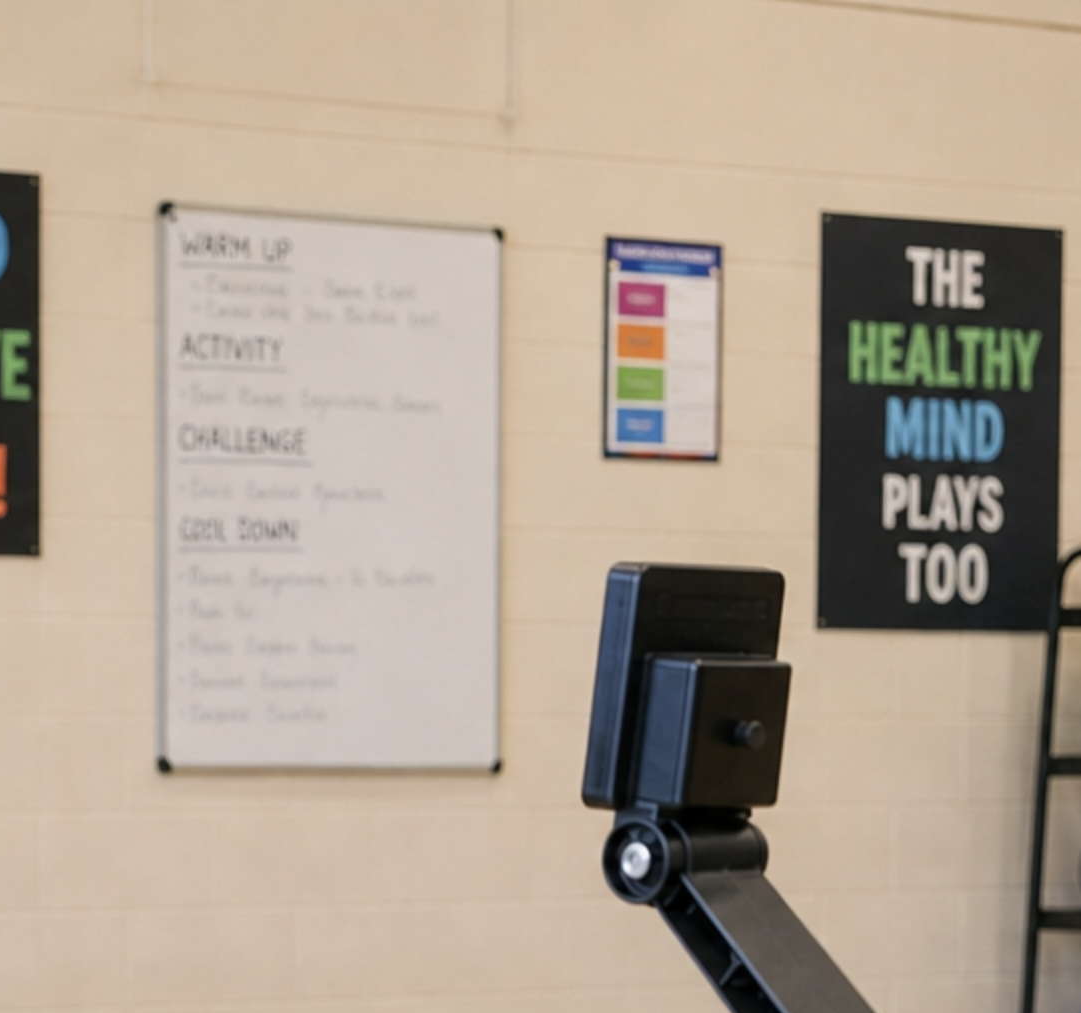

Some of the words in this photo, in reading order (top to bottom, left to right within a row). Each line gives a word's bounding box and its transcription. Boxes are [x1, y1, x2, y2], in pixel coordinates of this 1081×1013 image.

[179, 231, 252, 260] WARM
[260, 235, 294, 263] UP
[904, 245, 986, 309] THE
[178, 331, 285, 363] ACTIVITY
[847, 319, 1043, 392] HEALTHY
[176, 421, 308, 456] CHALLENGE
[884, 396, 1005, 463] MIND
[881, 472, 1004, 534] PLAYS
[897, 542, 989, 605] TOO
